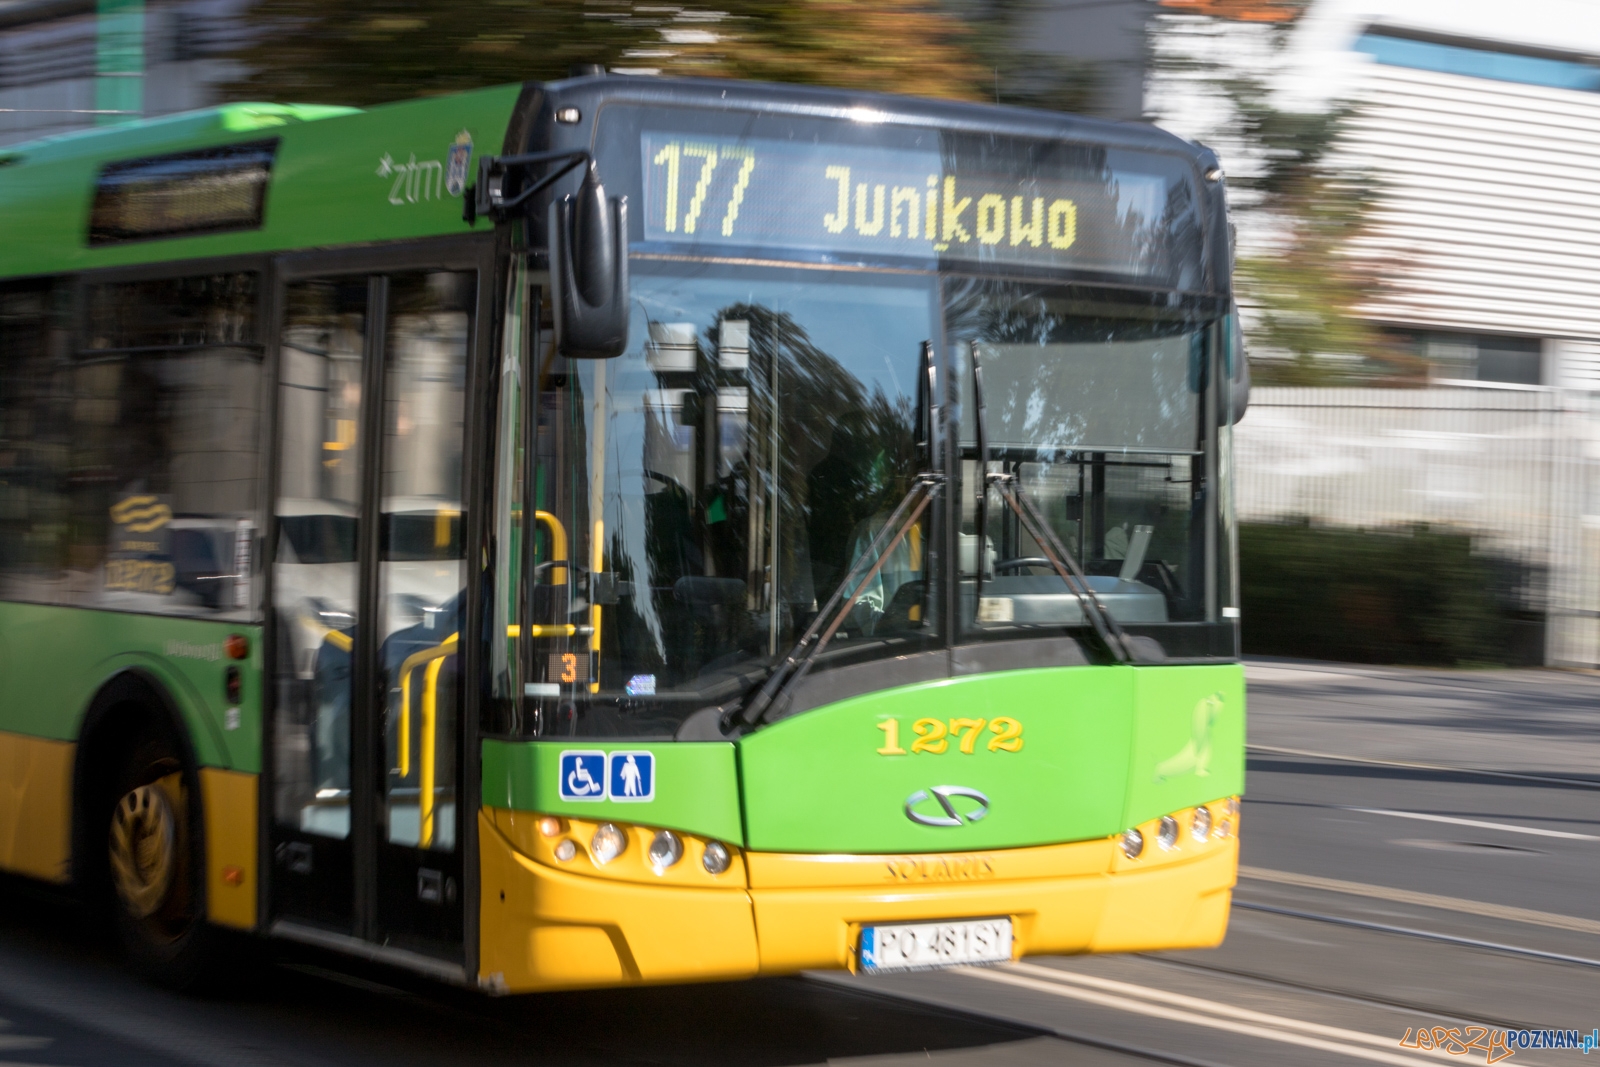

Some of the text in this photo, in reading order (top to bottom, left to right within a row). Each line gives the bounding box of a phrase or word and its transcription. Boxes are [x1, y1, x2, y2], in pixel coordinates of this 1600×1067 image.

[654, 139, 1078, 250] 177 Junikowo
[561, 652, 577, 683] 3
[875, 716, 1025, 756] 1272
[884, 856, 996, 885] SOLARIS
[878, 927, 917, 966] PO
